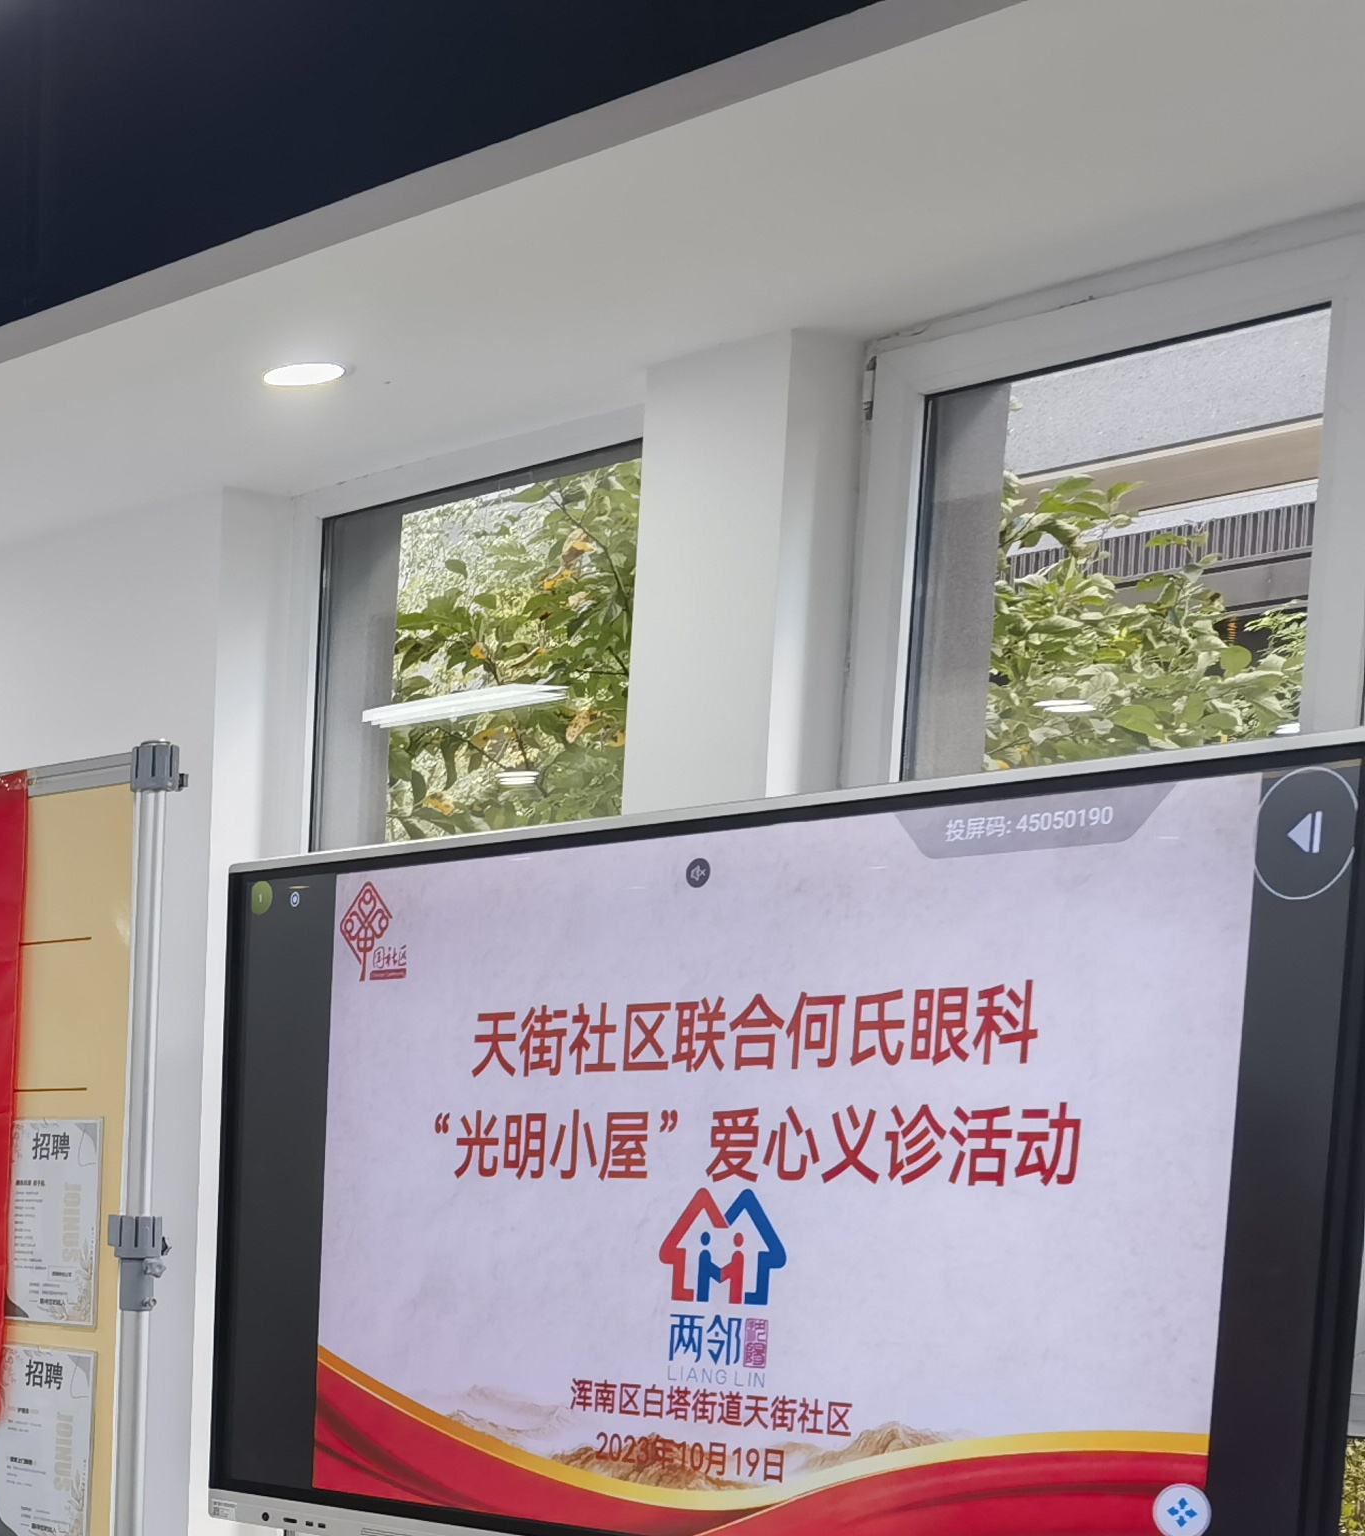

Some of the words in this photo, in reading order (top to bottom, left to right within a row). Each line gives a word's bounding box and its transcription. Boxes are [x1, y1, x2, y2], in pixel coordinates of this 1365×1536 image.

[945, 814, 1012, 842] 投屏码:
[1015, 806, 1114, 833] 45050190
[471, 979, 1039, 1078] 天街社区联合何氏眼科
[32, 1132, 71, 1161] 招聘
[668, 1314, 743, 1366] 两邻
[25, 1359, 64, 1390] 招聘
[667, 1365, 728, 1385] LIANG
[733, 1370, 766, 1389] LIN
[570, 1377, 853, 1437] 浑南区白塔街道天街社区
[595, 1431, 785, 1484] 2023年10月19日
